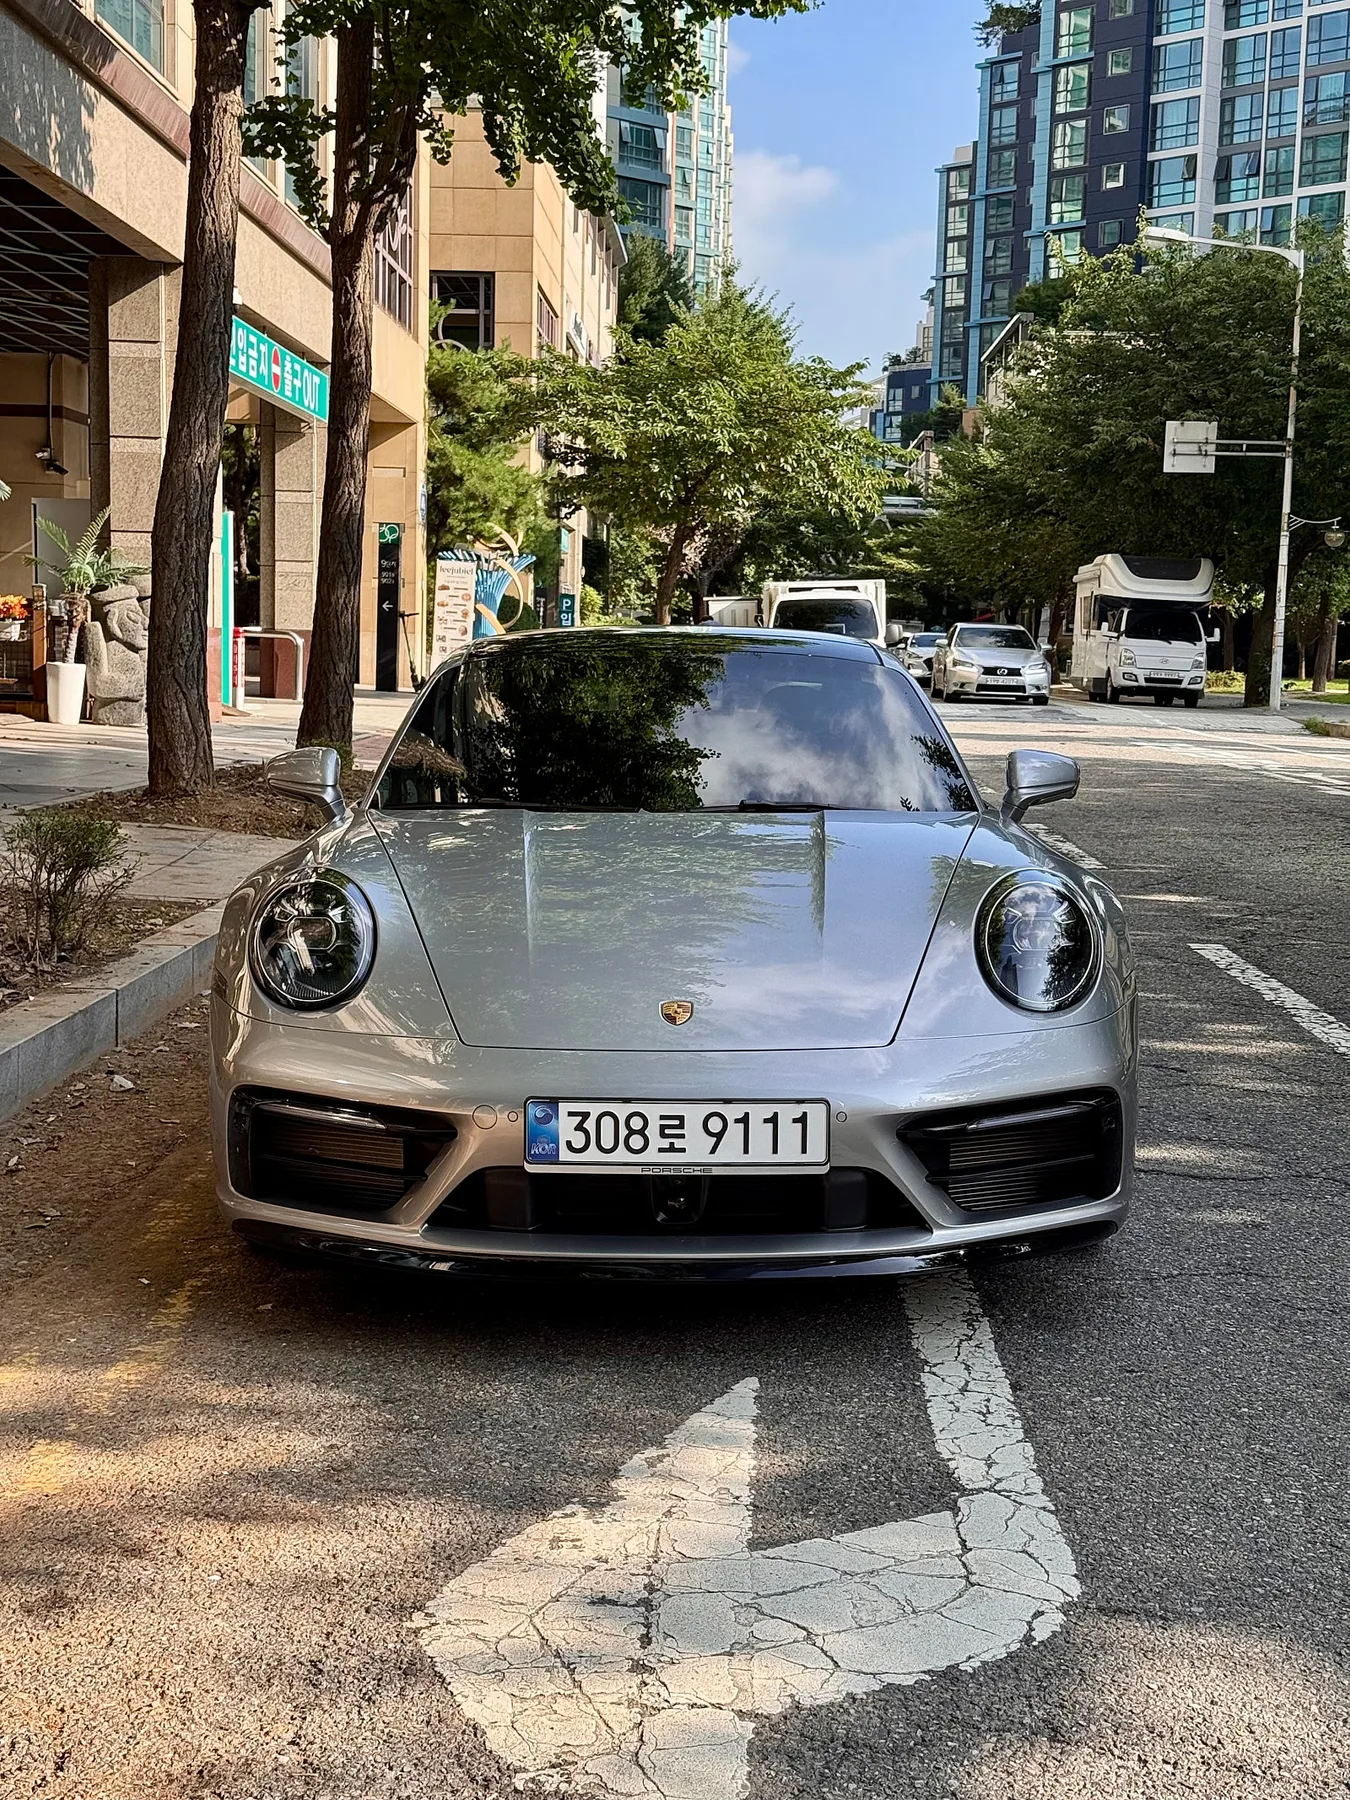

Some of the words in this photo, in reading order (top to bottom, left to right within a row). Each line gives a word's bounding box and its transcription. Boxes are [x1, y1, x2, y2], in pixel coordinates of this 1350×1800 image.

[283, 354, 301, 402] 출구
[302, 368, 320, 412] OUT
[562, 598, 572, 611] P
[565, 1110, 687, 1155] 308로
[702, 1110, 808, 1156] 9111
[531, 1142, 557, 1155] KOR
